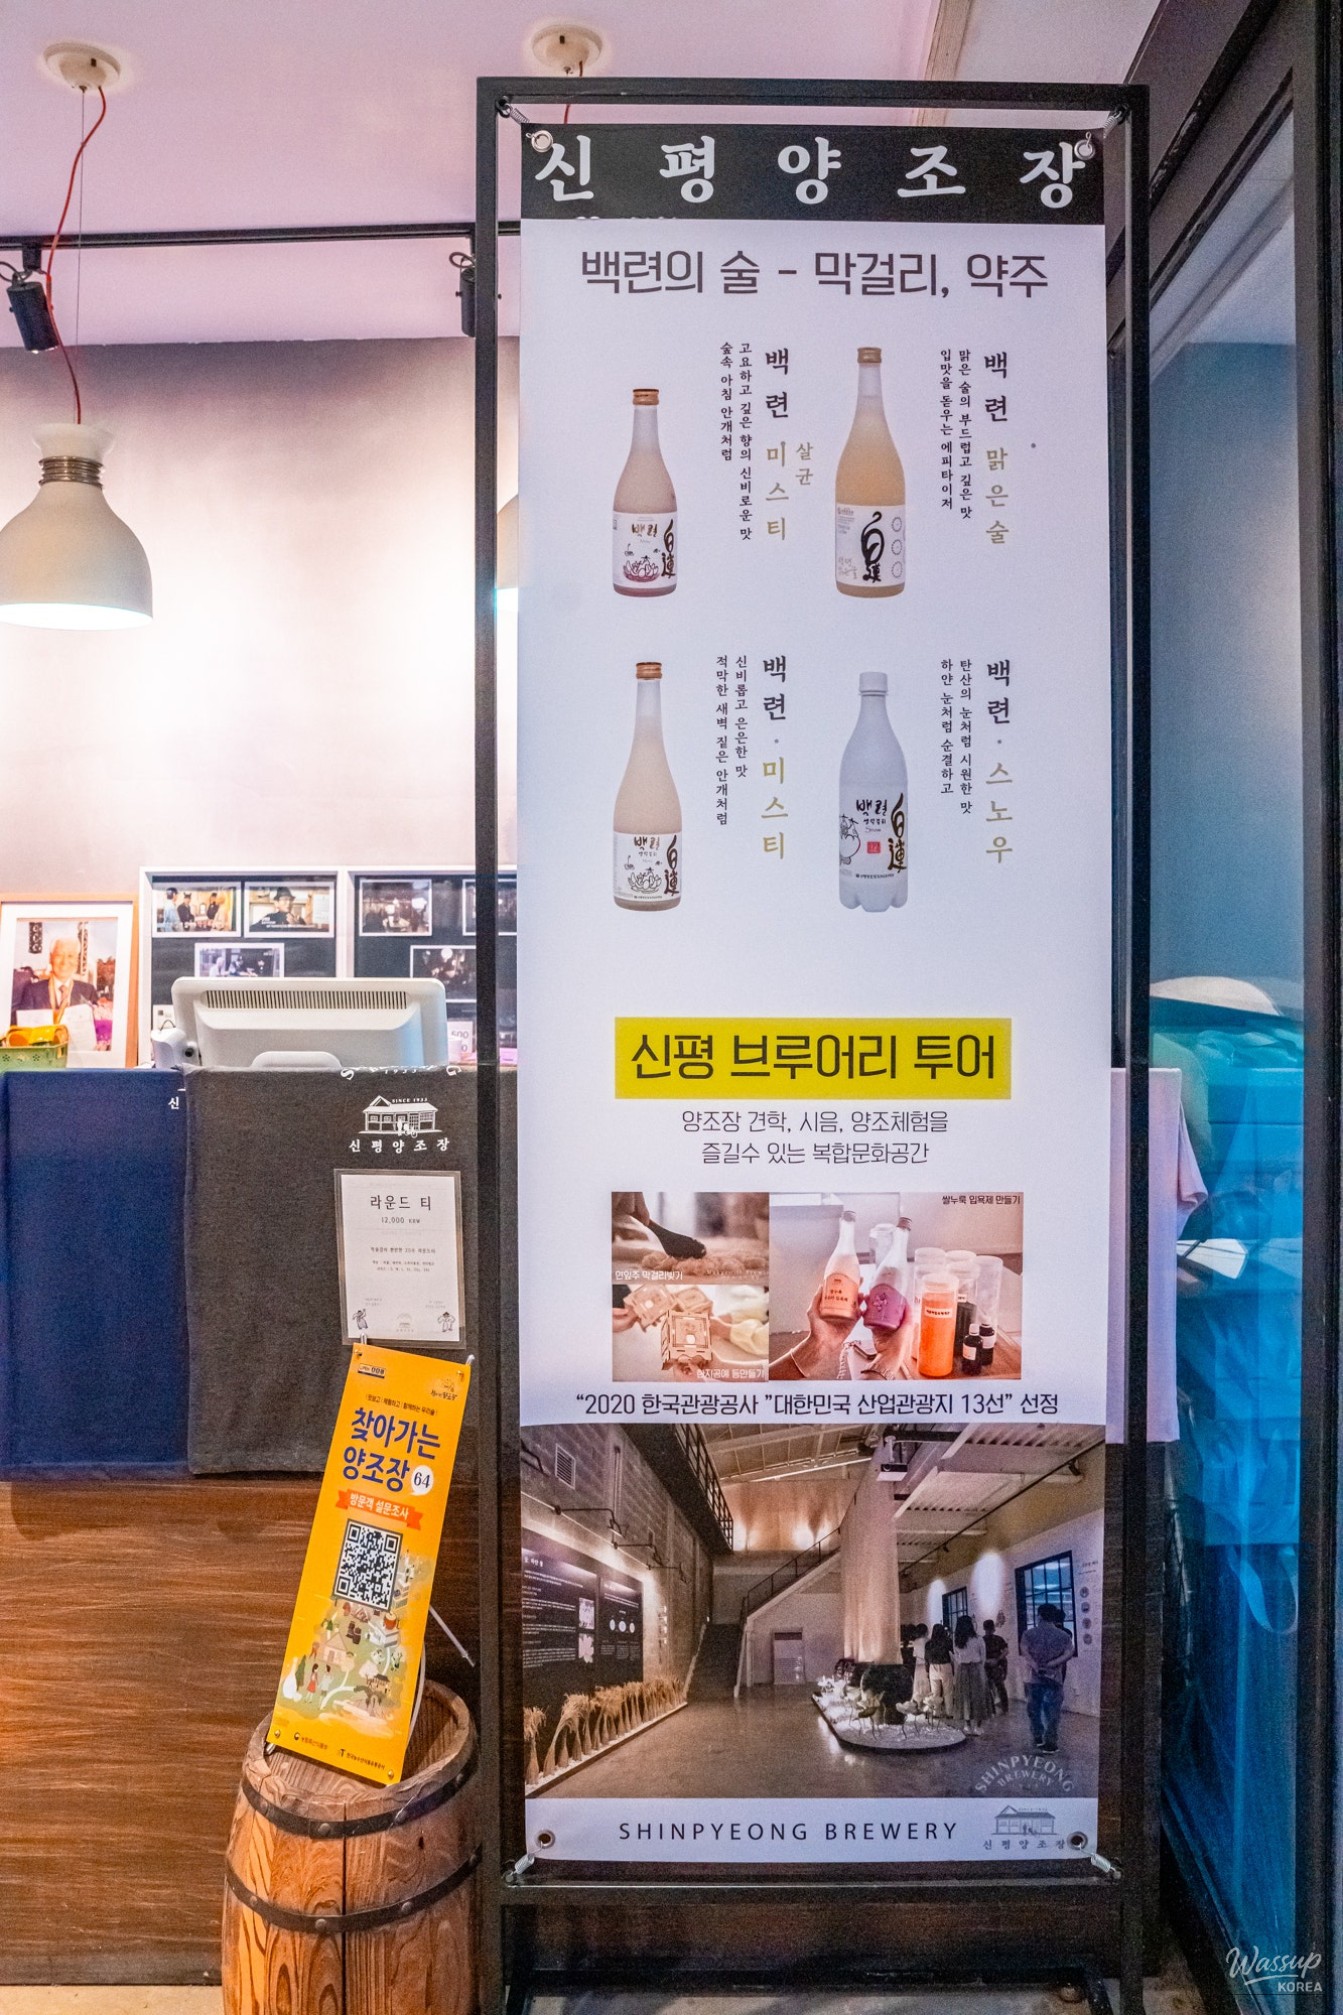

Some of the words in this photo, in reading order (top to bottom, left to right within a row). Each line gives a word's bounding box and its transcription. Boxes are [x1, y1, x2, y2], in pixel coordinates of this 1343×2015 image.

[582, 250, 703, 294] 백련의
[720, 250, 760, 295] 술
[815, 252, 950, 299] 막걸리,
[966, 253, 1049, 299] 약주
[720, 341, 733, 369] 숲속
[739, 342, 753, 395] 고요하고
[940, 348, 953, 390] 입맛을
[958, 348, 972, 376] 맑은
[720, 373, 734, 401] 아침
[765, 347, 789, 419] 백련
[958, 381, 972, 408] 술의
[983, 351, 1008, 422] 백련
[720, 406, 734, 462] 안개처럼
[739, 401, 753, 429] 깊은
[940, 395, 954, 436] 돋우는
[739, 433, 753, 461] 향의
[958, 413, 973, 467] 부드럽고
[795, 441, 814, 486] 살균
[940, 440, 954, 510] 에피타이저
[739, 466, 753, 522] 신비로운
[765, 440, 790, 541] 미스티
[960, 473, 973, 501] 깊은
[739, 527, 753, 541] 맛
[960, 506, 973, 520] 맛
[715, 654, 729, 697] 적막한
[734, 654, 748, 710] 신비롭고
[940, 658, 954, 686] 하얀
[959, 658, 973, 701] 탄산의
[715, 702, 728, 730] 새벽
[940, 692, 954, 734] 눈처럼
[959, 706, 973, 748] 눈처럼
[715, 735, 729, 764] 짙은
[734, 716, 748, 759] 은은한
[735, 764, 748, 778] 맛
[940, 738, 954, 794] 순결하고
[959, 753, 973, 796] 시원한
[715, 768, 729, 826] 안개처럼
[760, 756, 789, 860] 미스티
[960, 800, 973, 815] 맛
[985, 762, 1013, 864] 스노우
[631, 1034, 714, 1080] 신평
[730, 1034, 897, 1080] 브루어리
[913, 1034, 995, 1080] 투어
[682, 1110, 742, 1133] 양조장
[747, 1110, 792, 1133] 견학,
[799, 1111, 843, 1134] 시음,
[851, 1110, 949, 1133] 양조체험을
[702, 1142, 760, 1164] 즐길수
[767, 1142, 806, 1164] 있는
[812, 1142, 930, 1164] 복합문화공간
[370, 1194, 411, 1211] 라운드
[420, 1195, 431, 1211] 티
[641, 1393, 759, 1416] 한국관광공사
[857, 1393, 953, 1416] 산업관광지
[1020, 1393, 1058, 1415] 선정
[351, 1406, 441, 1460] 찾아가는
[342, 1446, 410, 1493] 양조장
[413, 1471, 431, 1489] 64
[350, 1493, 374, 1512] 방문객
[376, 1501, 409, 1521] 설문조사
[619, 1822, 807, 1841] SHINPYEONG
[825, 1822, 957, 1841] BREWERY
